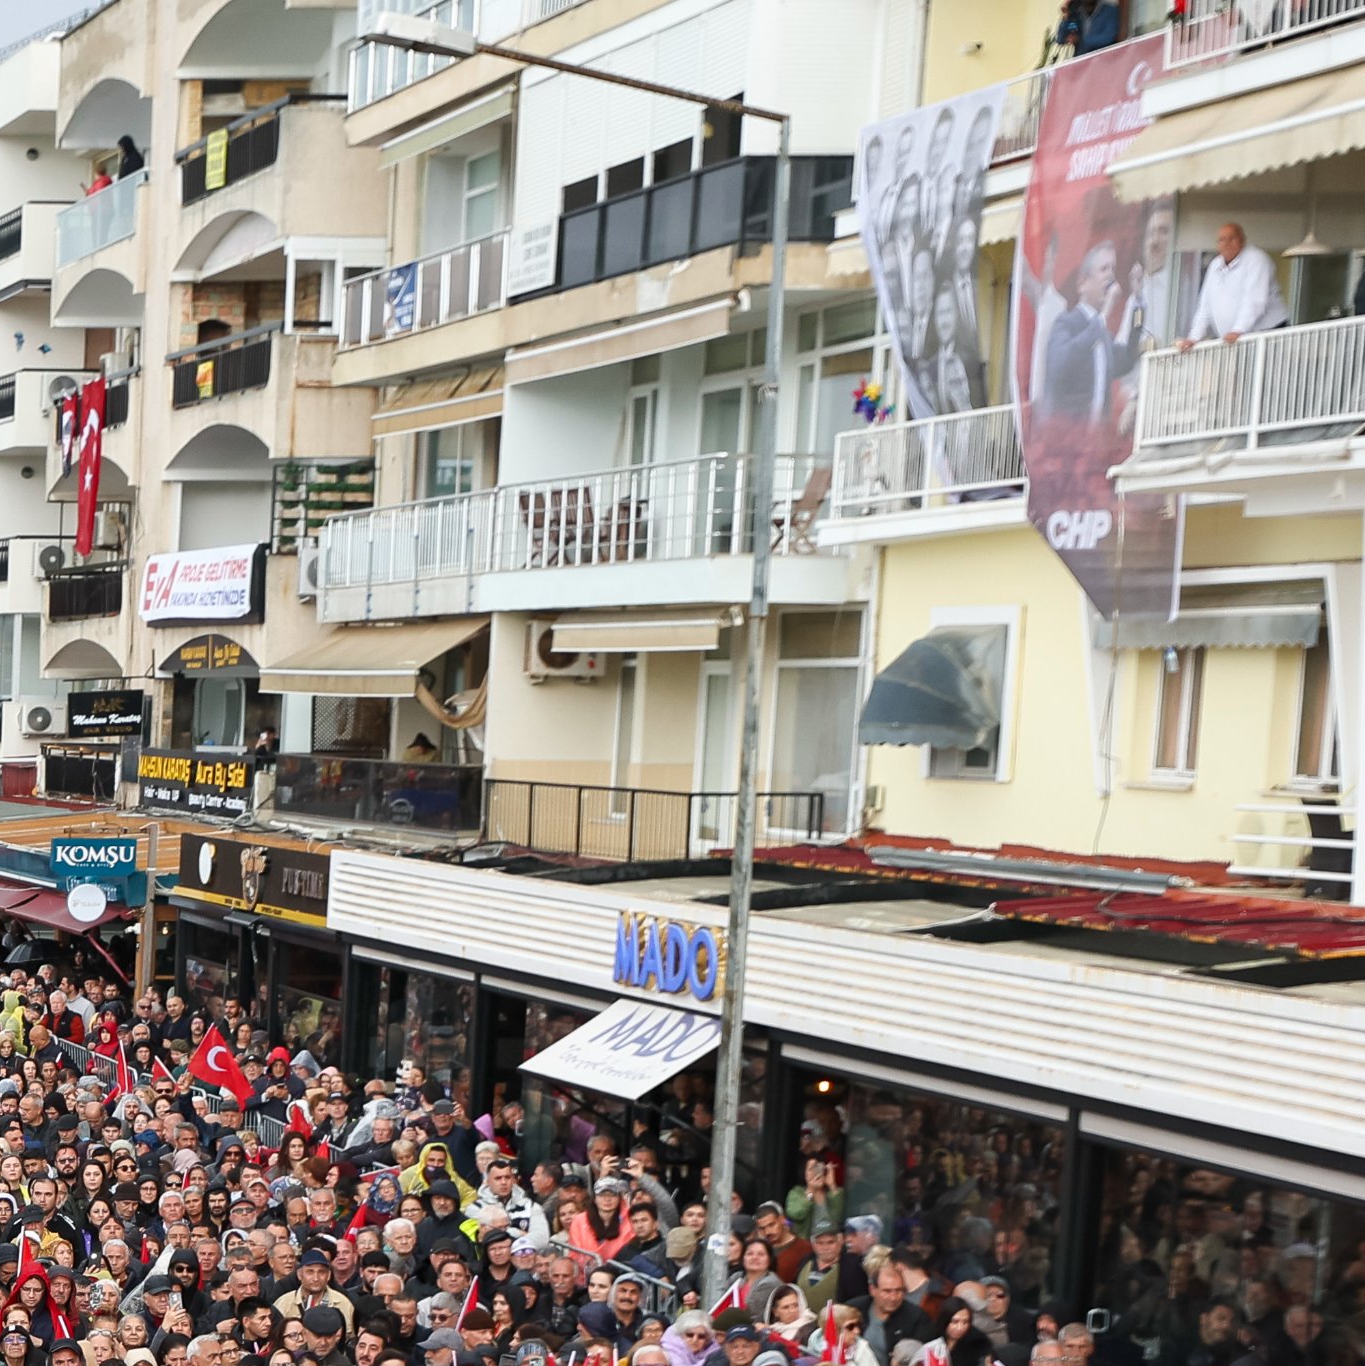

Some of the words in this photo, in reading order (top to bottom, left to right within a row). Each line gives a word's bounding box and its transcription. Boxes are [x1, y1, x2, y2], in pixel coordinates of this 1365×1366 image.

[1047, 508, 1113, 550] CHP
[214, 762, 227, 793] By
[55, 846, 135, 868] KOMŞU
[613, 913, 717, 1000] MADO
[589, 1005, 722, 1062] MADO
